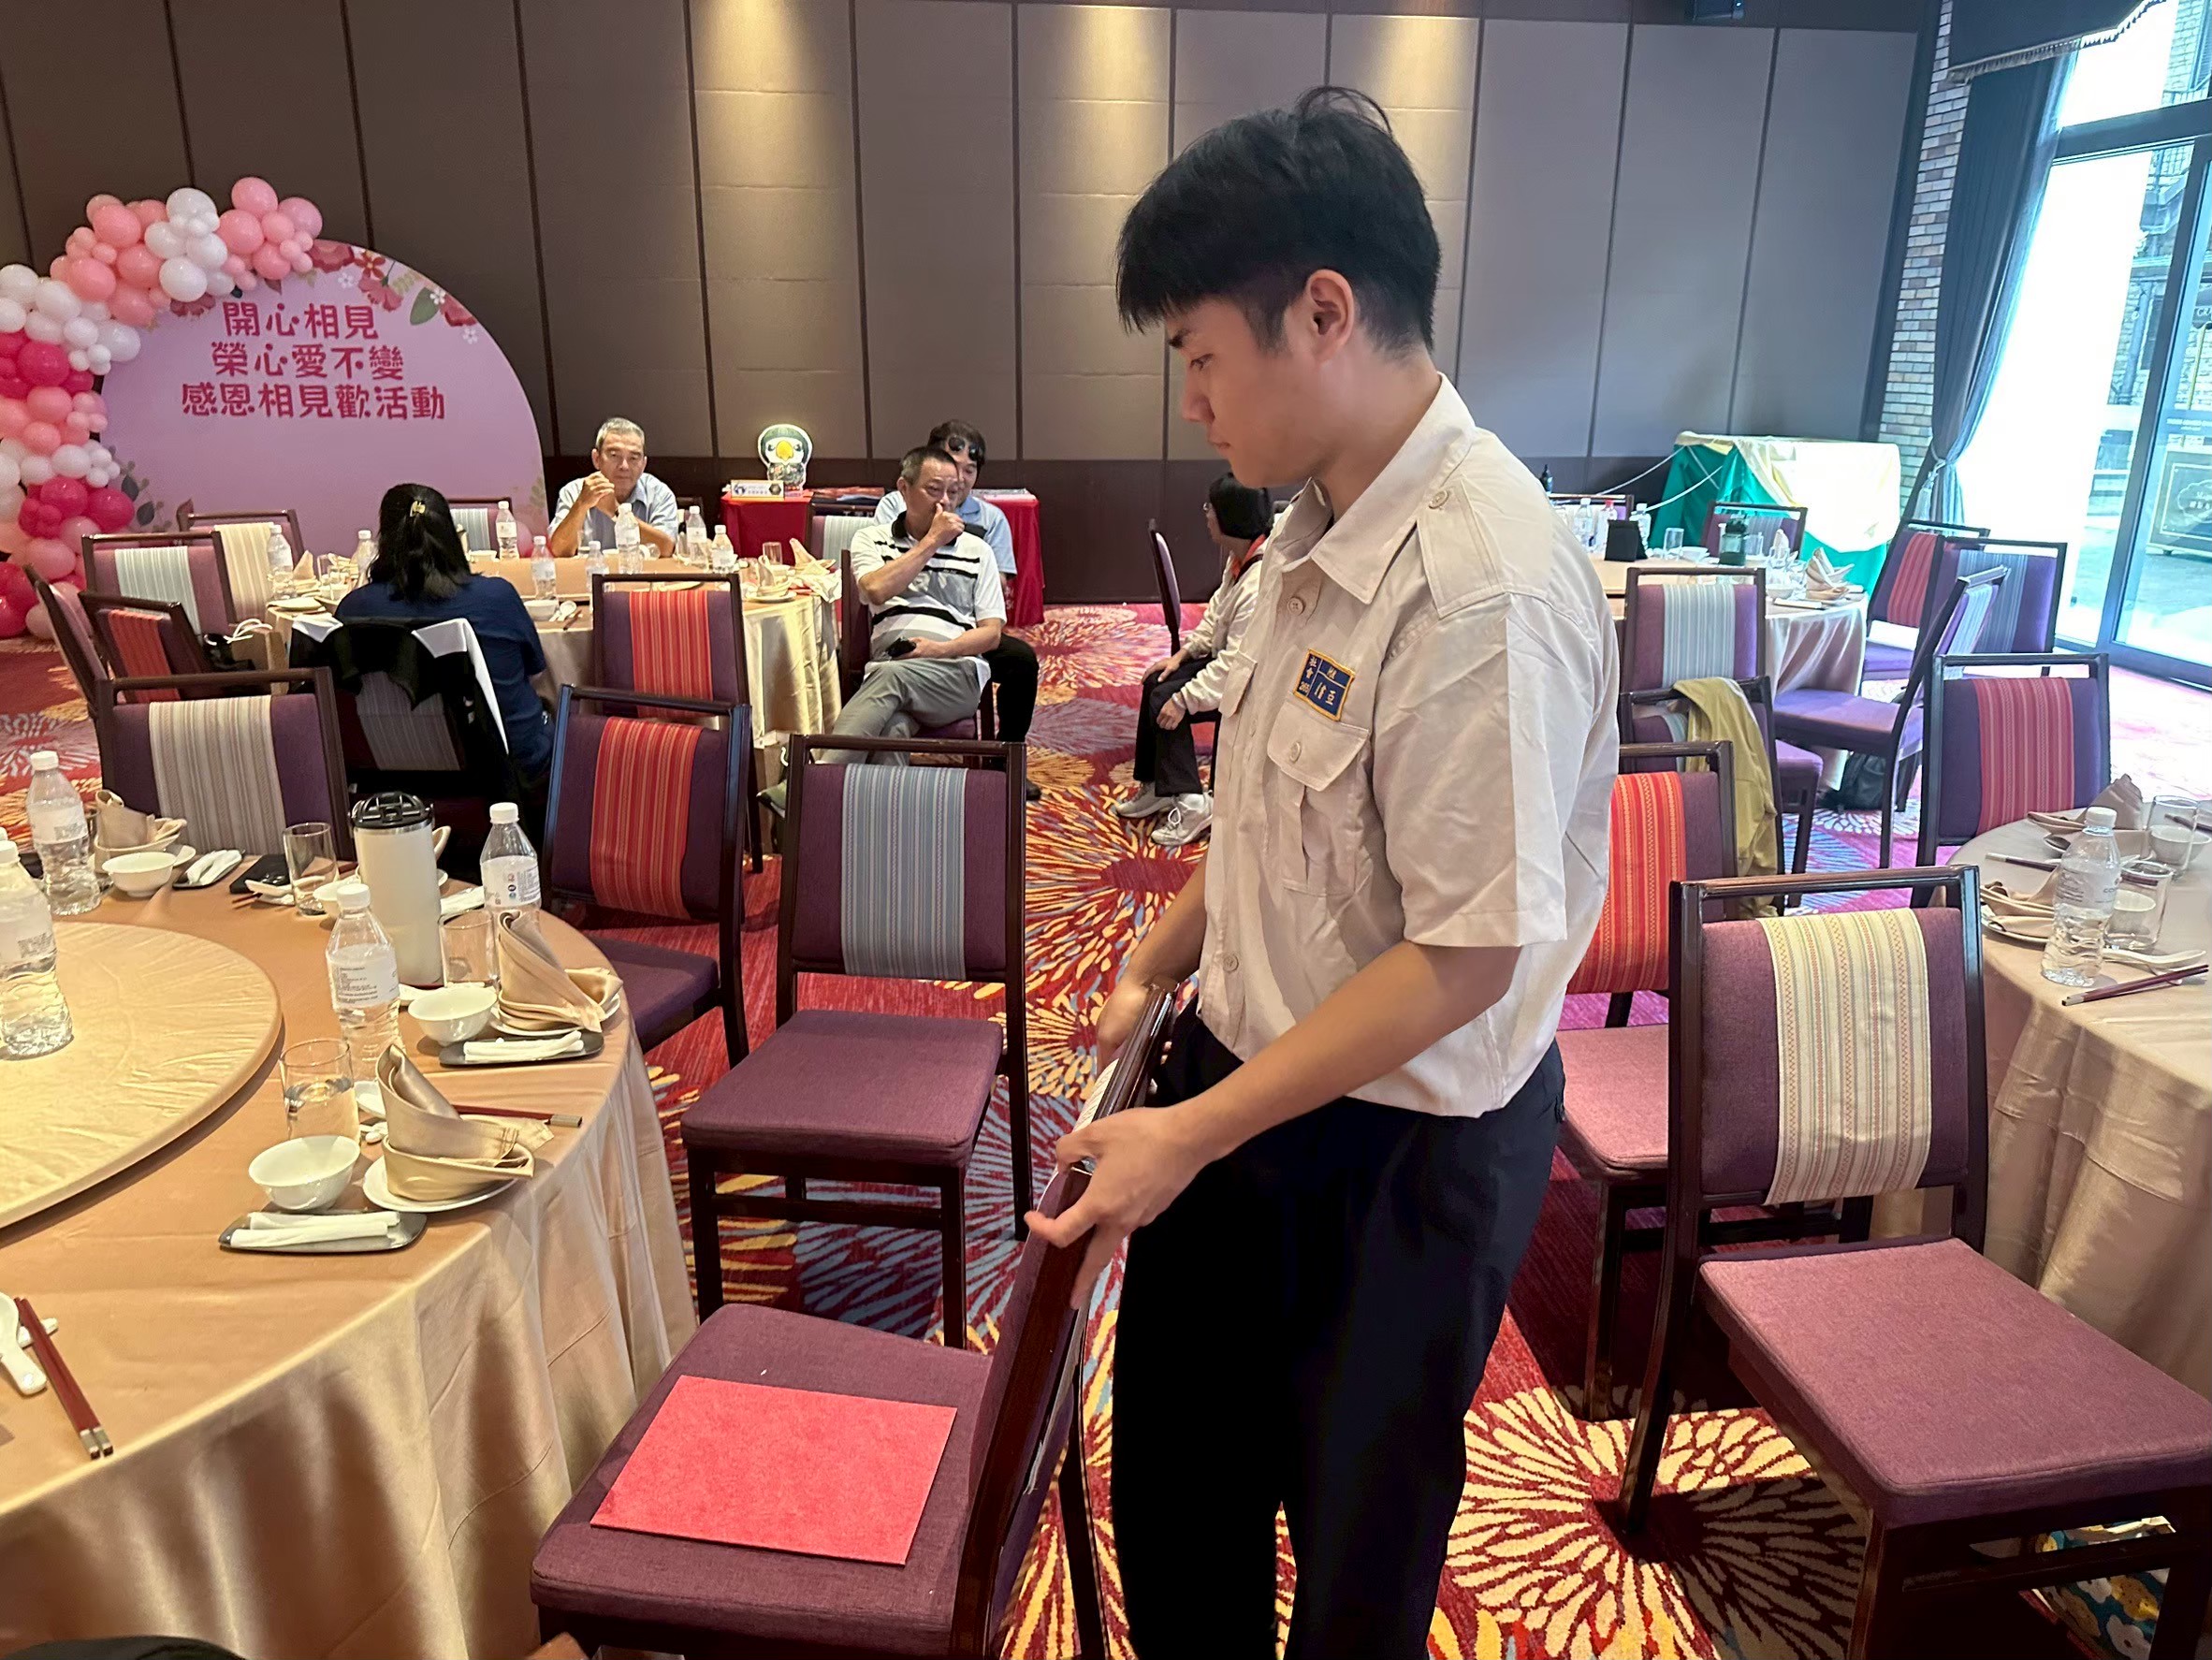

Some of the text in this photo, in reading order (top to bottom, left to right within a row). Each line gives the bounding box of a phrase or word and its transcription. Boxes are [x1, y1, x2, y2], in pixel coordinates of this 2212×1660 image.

[222, 300, 379, 339] 開心相見
[211, 341, 404, 381] 榮心愛不變
[182, 381, 445, 420] 感恩相見歡活動
